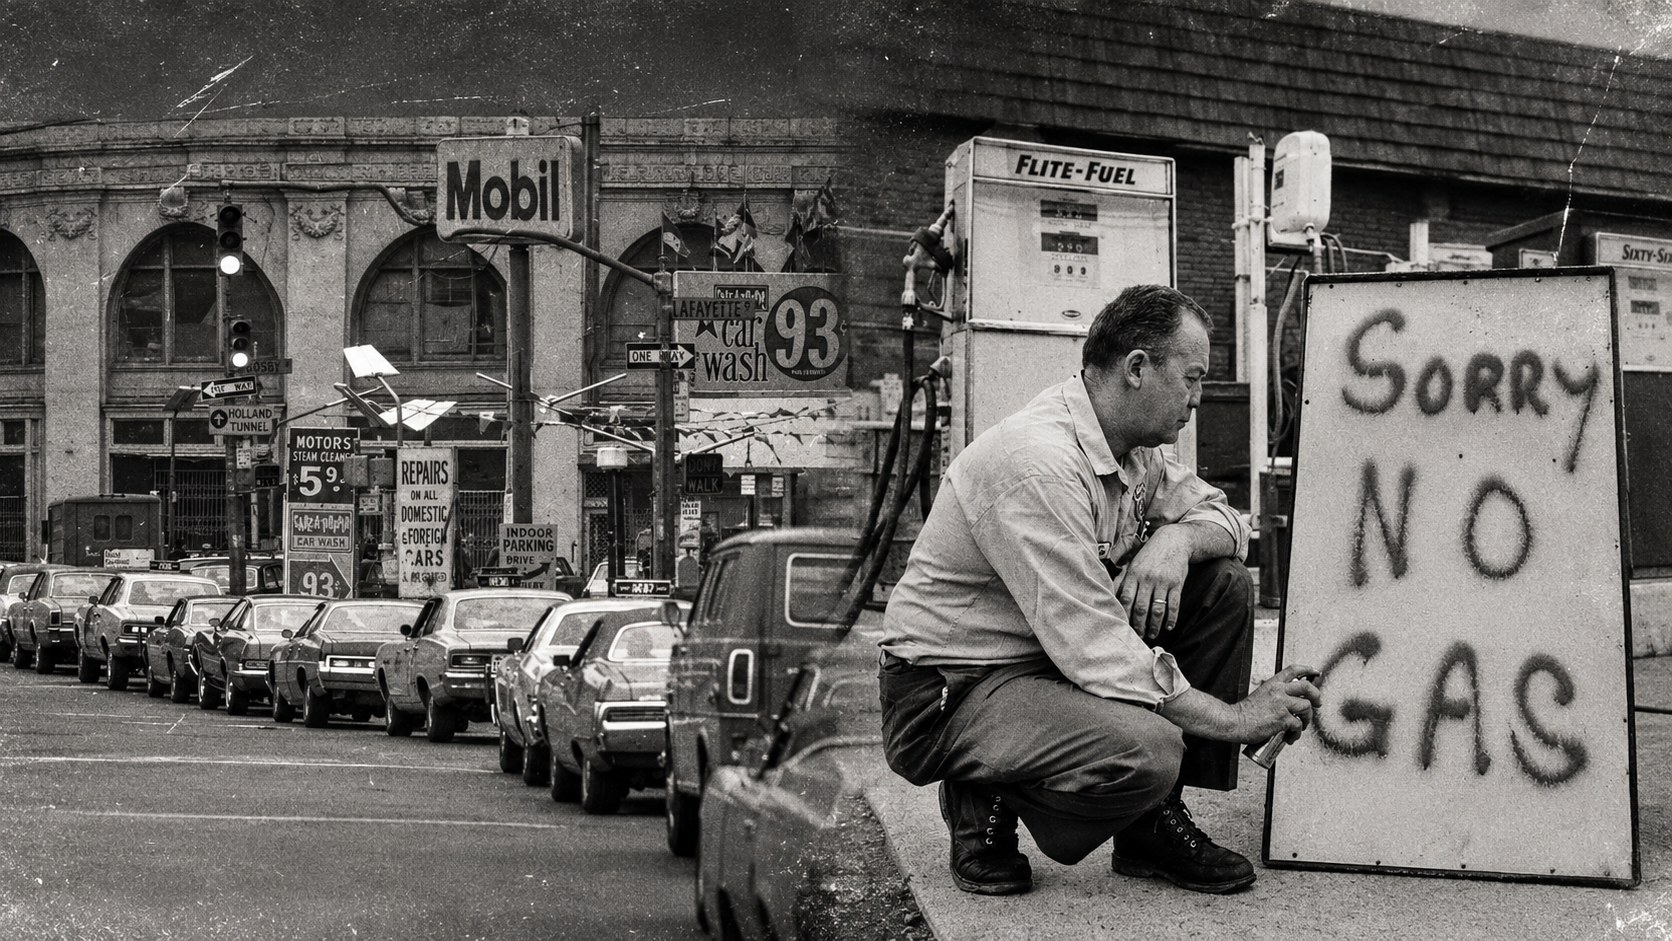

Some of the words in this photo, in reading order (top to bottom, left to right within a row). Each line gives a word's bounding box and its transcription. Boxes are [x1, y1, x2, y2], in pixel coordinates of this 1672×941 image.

[1015, 154, 1136, 185] FLITE-FUEL
[446, 159, 560, 221] Mobil
[673, 300, 741, 318] LAFAYETTE
[721, 317, 763, 348] car
[632, 351, 652, 361] ONE
[702, 342, 768, 382] wash
[1342, 308, 1601, 475] SORRY
[228, 408, 273, 419] HOLLAND
[229, 421, 269, 432] TUNNEL
[296, 435, 351, 450] MOTORS
[293, 451, 318, 461] STEAM
[401, 460, 449, 486] REPAIRS
[688, 478, 719, 492] WALK
[410, 490, 421, 500] ON
[423, 490, 439, 500] ALL
[401, 505, 448, 523] DOMESTIC
[1348, 458, 1534, 587] NO
[506, 527, 554, 539] INDOOR
[297, 537, 315, 547] CAR
[317, 537, 345, 548] WASH
[502, 539, 555, 553] PARKING
[506, 555, 535, 565] DRIVE
[1311, 630, 1589, 789] GAS
